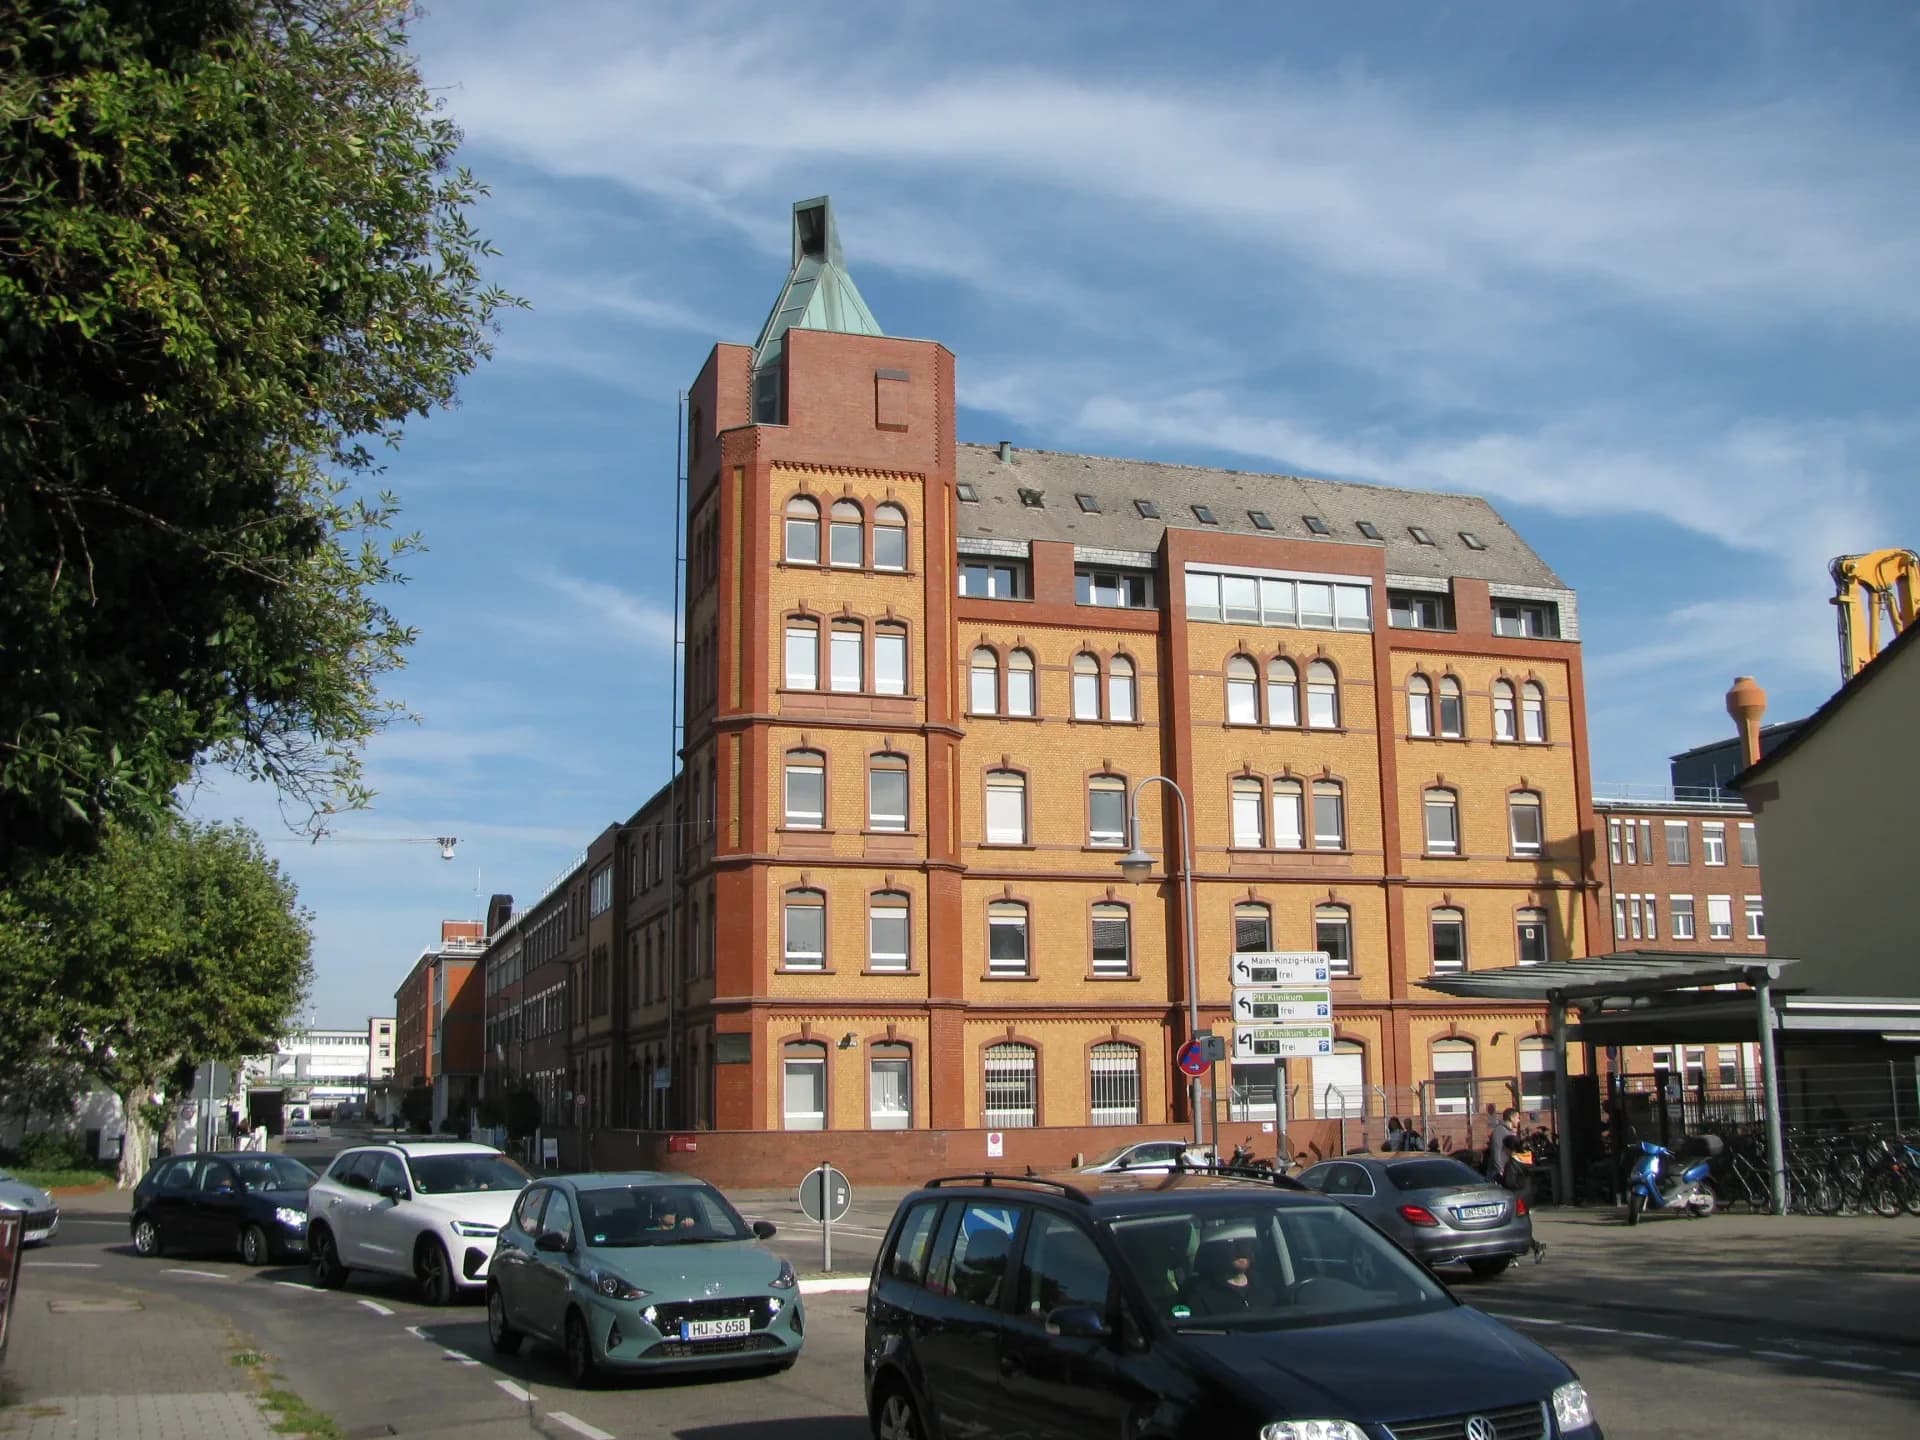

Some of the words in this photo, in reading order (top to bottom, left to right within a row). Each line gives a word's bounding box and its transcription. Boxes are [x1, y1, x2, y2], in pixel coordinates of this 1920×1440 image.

[1251, 956, 1325, 966] Main-Kinzig-Halle
[1279, 971, 1293, 979] frei
[1253, 992, 1265, 1002] PH
[1267, 992, 1304, 1001] Klinikum
[1281, 1007, 1295, 1015] frei
[1255, 1029, 1265, 1037] TG
[1268, 1029, 1304, 1037] Klinikum
[1307, 1028, 1323, 1037] Süd
[1263, 1041, 1278, 1053] 43
[1282, 1043, 1296, 1051] frei
[693, 1324, 708, 1336] HU
[715, 1322, 722, 1334] S
[725, 1320, 745, 1333] 658
